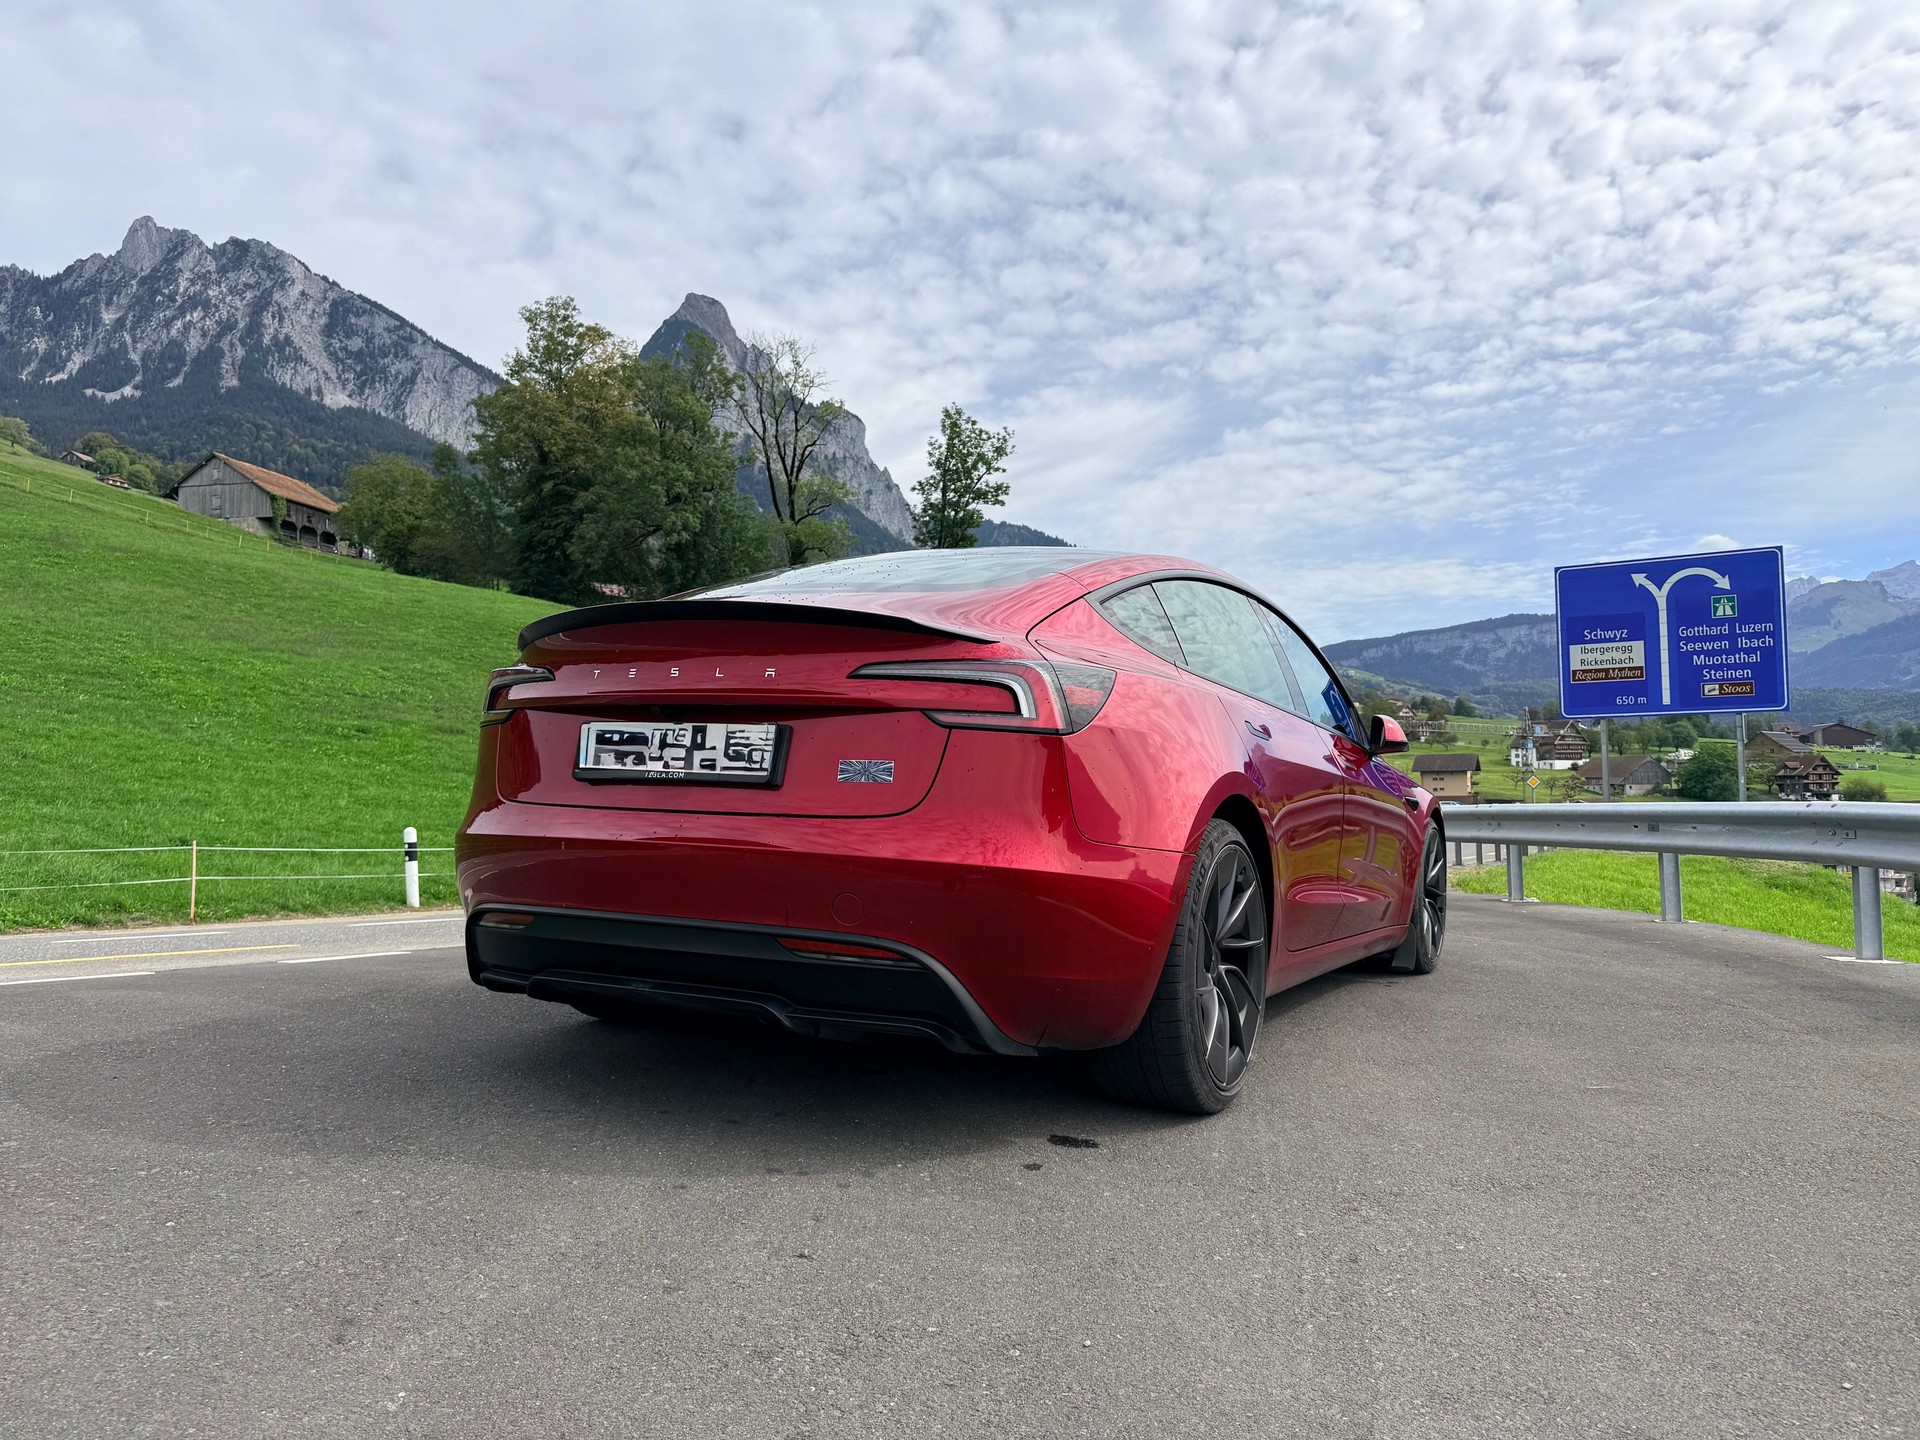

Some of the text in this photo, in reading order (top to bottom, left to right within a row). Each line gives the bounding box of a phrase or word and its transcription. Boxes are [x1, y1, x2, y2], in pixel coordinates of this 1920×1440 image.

[1584, 628, 1628, 641] Schwyz
[1678, 621, 1774, 638] Gotthard Luzern
[1580, 644, 1633, 655] Ibergeregg
[1679, 635, 1774, 652] Seewen Ibach
[1580, 656, 1634, 667] Rickenbach
[1693, 651, 1761, 666] Muotathal
[593, 667, 776, 680] TESLA
[1575, 668, 1641, 682] Region Mythen
[1703, 668, 1752, 680] Steinen
[1721, 684, 1751, 694] Stoos
[1616, 696, 1647, 706] 650 m
